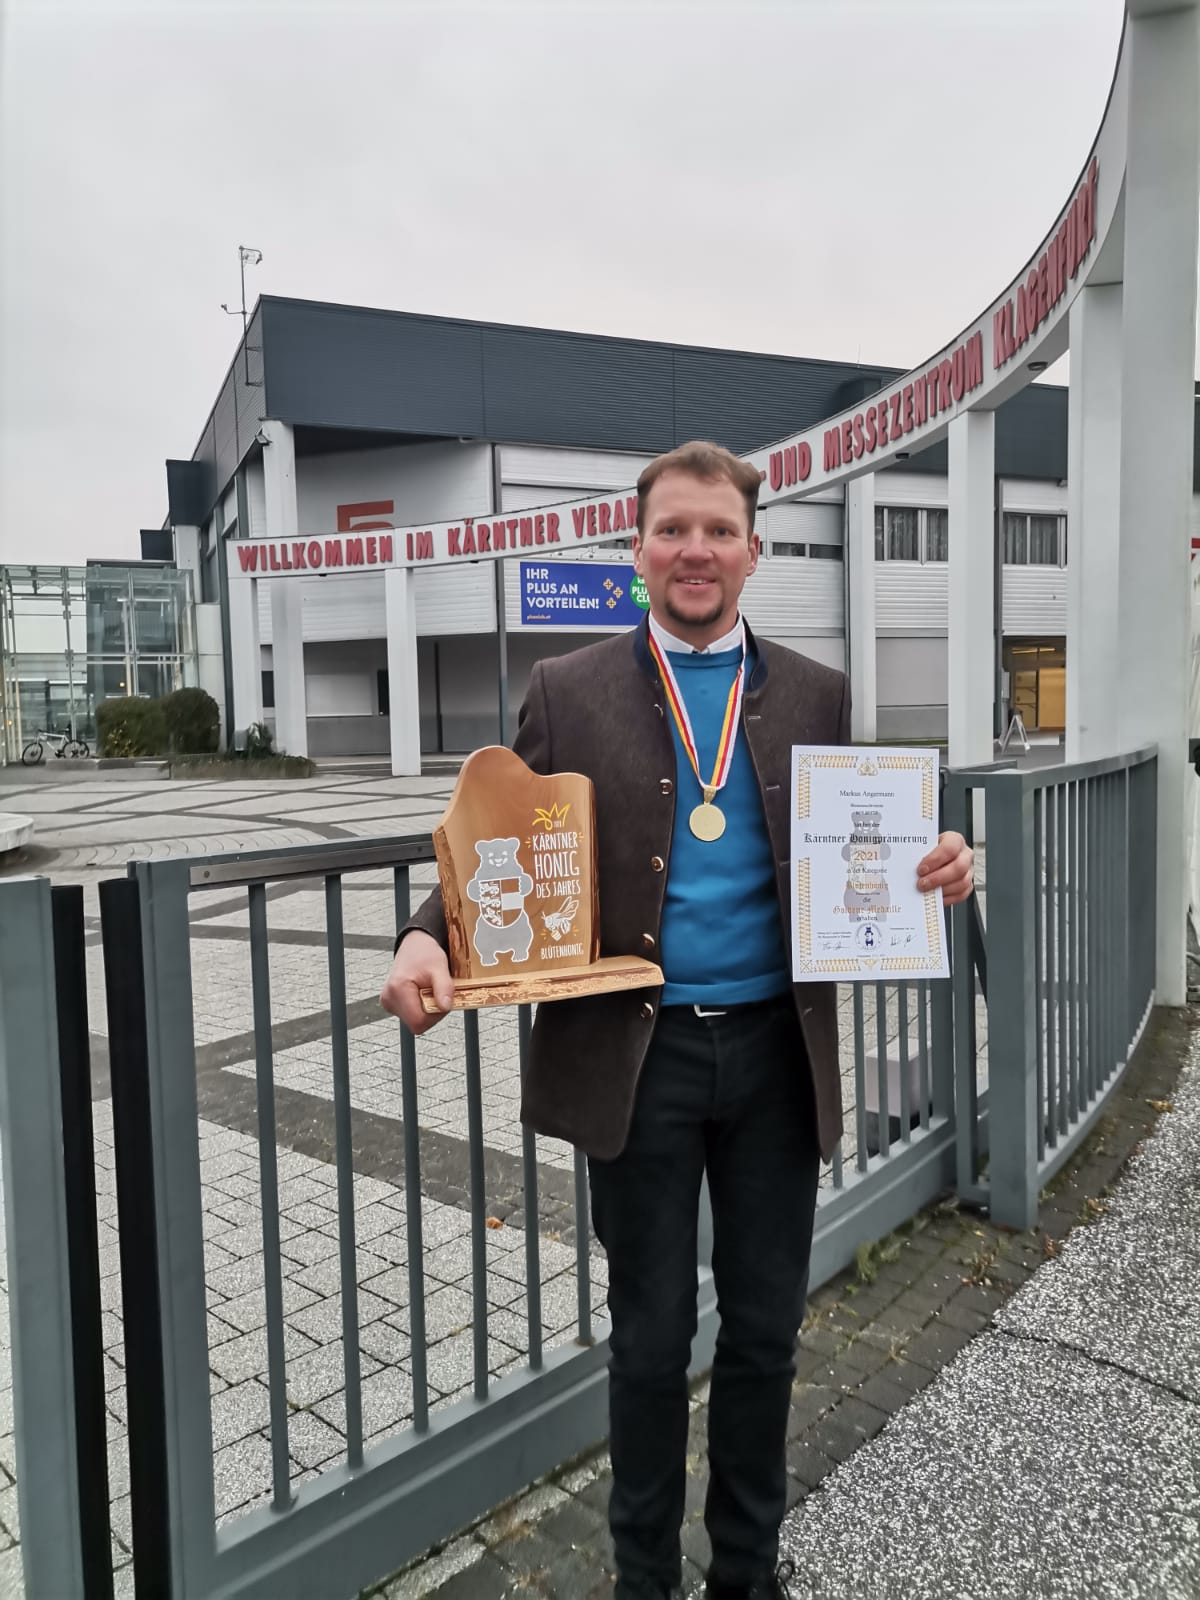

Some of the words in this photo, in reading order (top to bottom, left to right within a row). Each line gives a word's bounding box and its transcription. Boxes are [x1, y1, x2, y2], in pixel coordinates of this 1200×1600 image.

[237, 535, 393, 571] WILLKOMMEN
[406, 531, 434, 560] IM
[447, 512, 560, 556] KÄRNTNER
[823, 330, 984, 473] MESSEZENTRUM
[993, 155, 1098, 370] KLAGENFURT
[526, 568, 549, 580] IHR
[526, 582, 557, 594] PLUS
[560, 583, 578, 595] AN
[527, 596, 599, 609] VORTEILEN!
[532, 832, 578, 851] KÄRNTNER
[803, 833, 846, 843] Kärntner
[849, 832, 928, 845] Honigprämierung
[853, 850, 878, 861] 2021
[534, 851, 580, 880] HONIG
[536, 882, 551, 899] DES
[552, 879, 581, 897] JAHRES
[541, 943, 584, 960] BLÜTENHONIG
